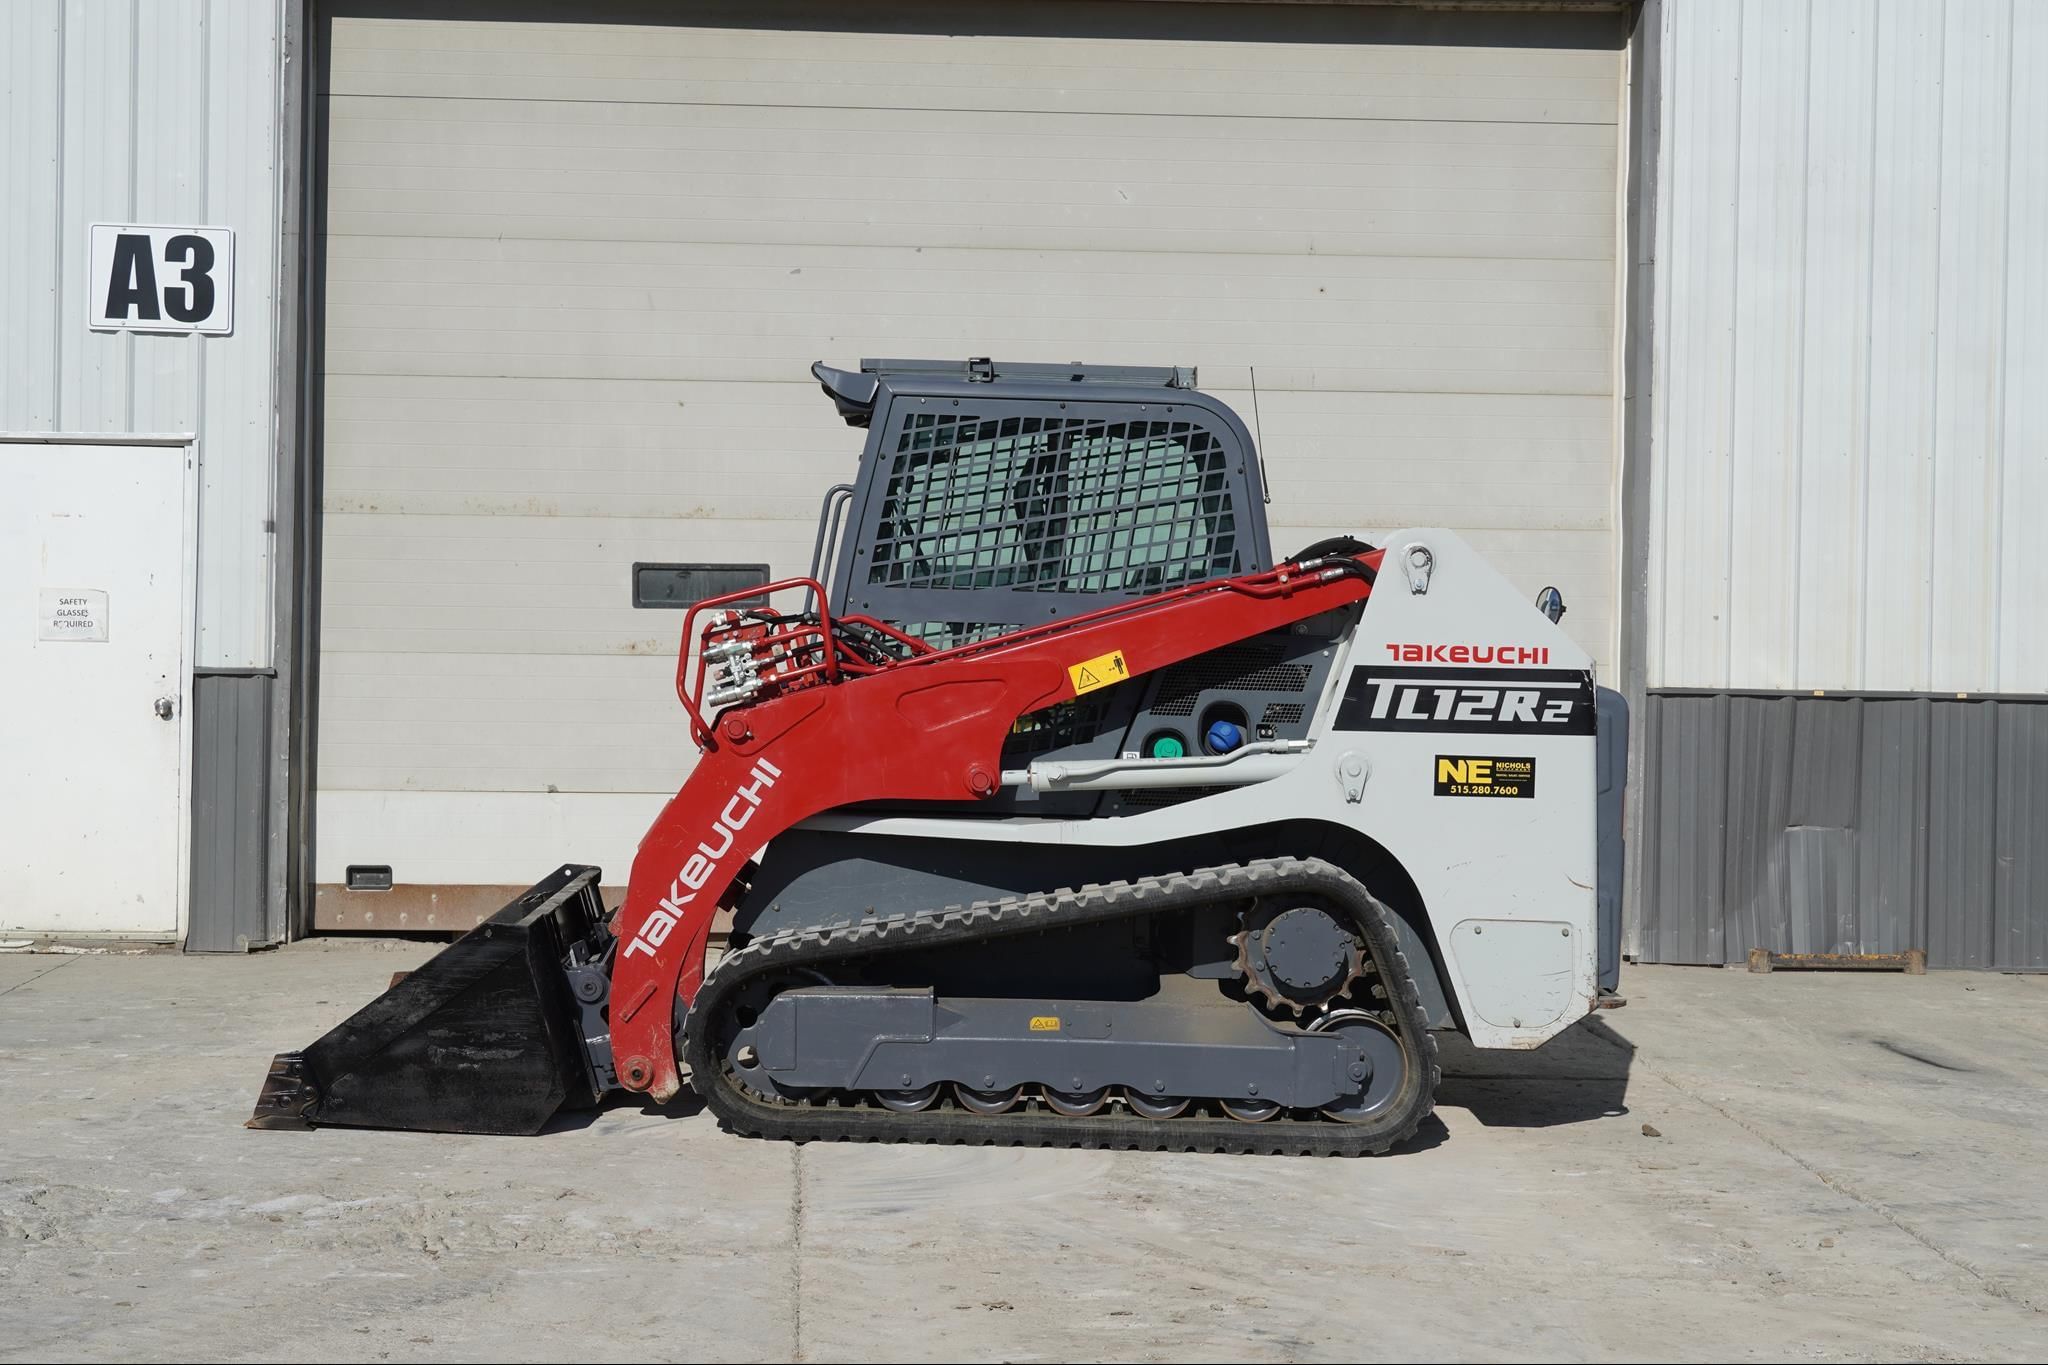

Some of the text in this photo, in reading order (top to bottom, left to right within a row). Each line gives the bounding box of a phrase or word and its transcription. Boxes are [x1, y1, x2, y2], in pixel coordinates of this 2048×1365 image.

[104, 233, 215, 323] A3
[59, 598, 88, 606] SAFETY
[1438, 759, 1493, 784] NE
[1450, 785, 1518, 795] 515.280.7600
